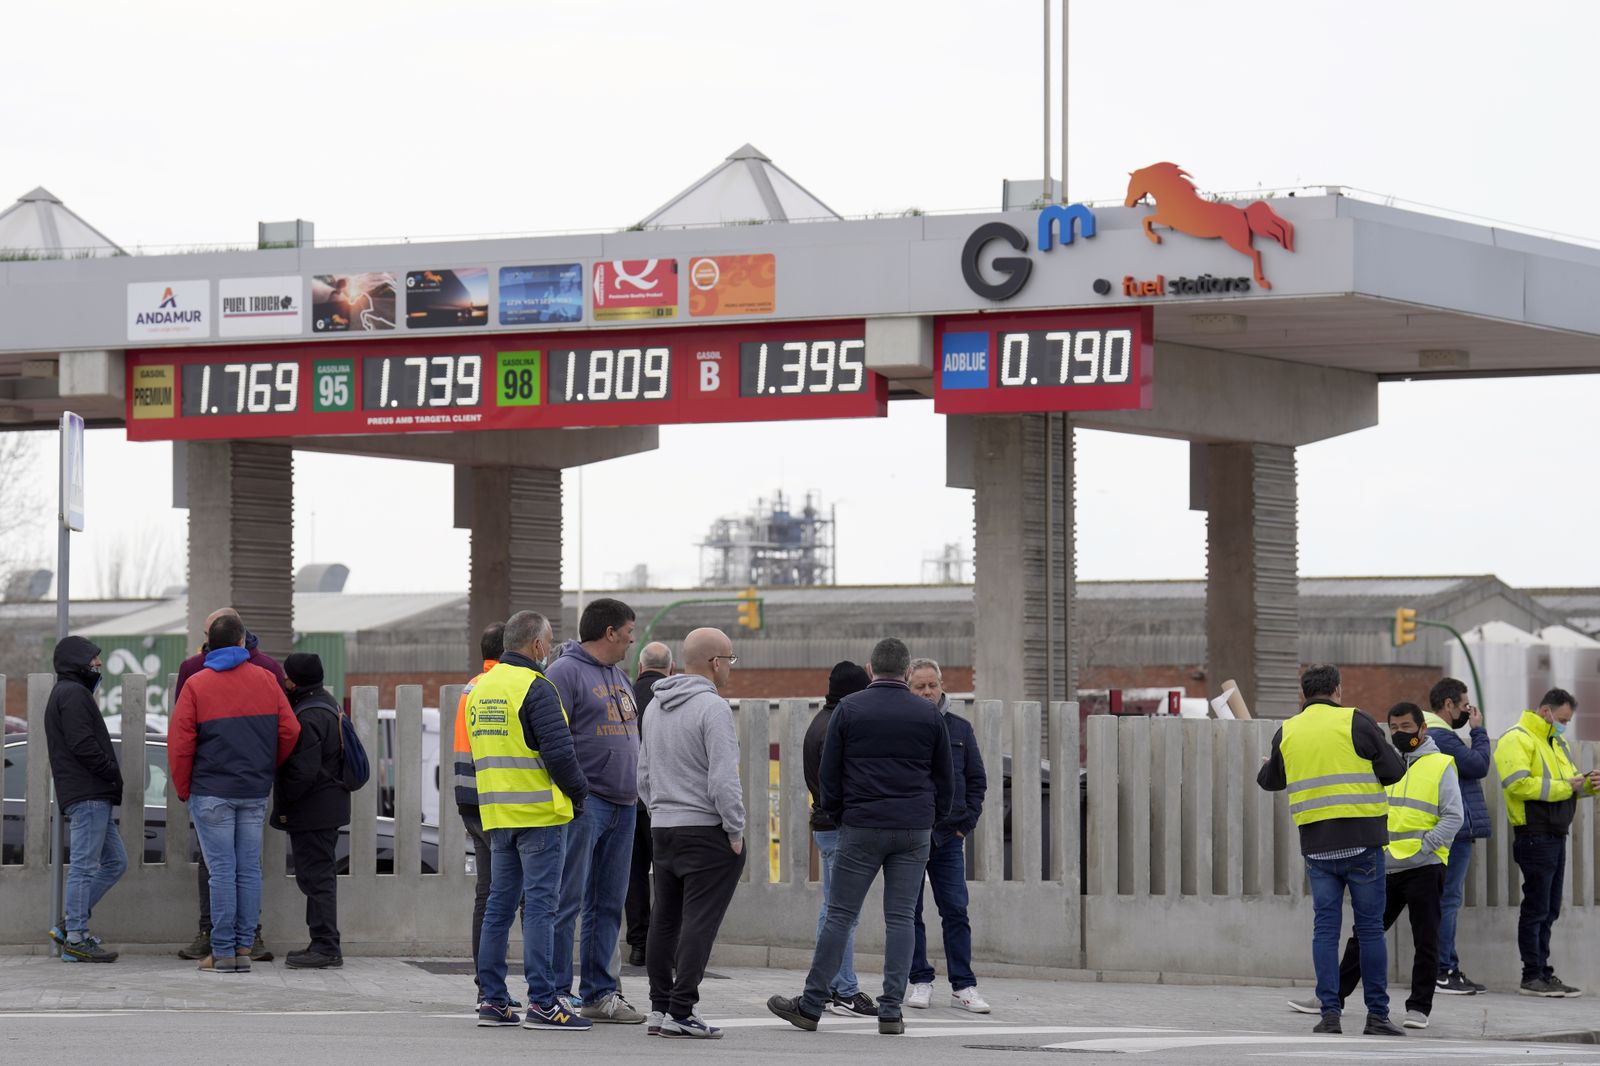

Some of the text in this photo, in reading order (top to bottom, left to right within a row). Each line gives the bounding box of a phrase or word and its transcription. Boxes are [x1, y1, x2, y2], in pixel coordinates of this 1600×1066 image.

[1122, 273, 1251, 297] fuel stations
[249, 296, 280, 311] TRUCK
[136, 310, 202, 325] ANDAMUR
[502, 358, 534, 366] GASOLINA
[696, 351, 722, 360] GASOIL
[943, 351, 986, 372] ADBLUE
[1001, 329, 1131, 386] 0.790
[140, 369, 166, 378] GASOIL
[317, 364, 350, 374] GASOLINA
[565, 348, 669, 401] 1.809
[700, 361, 720, 391] B
[757, 340, 865, 394] 1.395
[200, 362, 299, 414] 1.769
[319, 375, 348, 406] 95
[379, 355, 481, 408] 1.739
[504, 368, 533, 400] 98
[134, 387, 172, 406] PREMIUM
[367, 414, 482, 425] PREUS AMB TARGETA CLIENT
